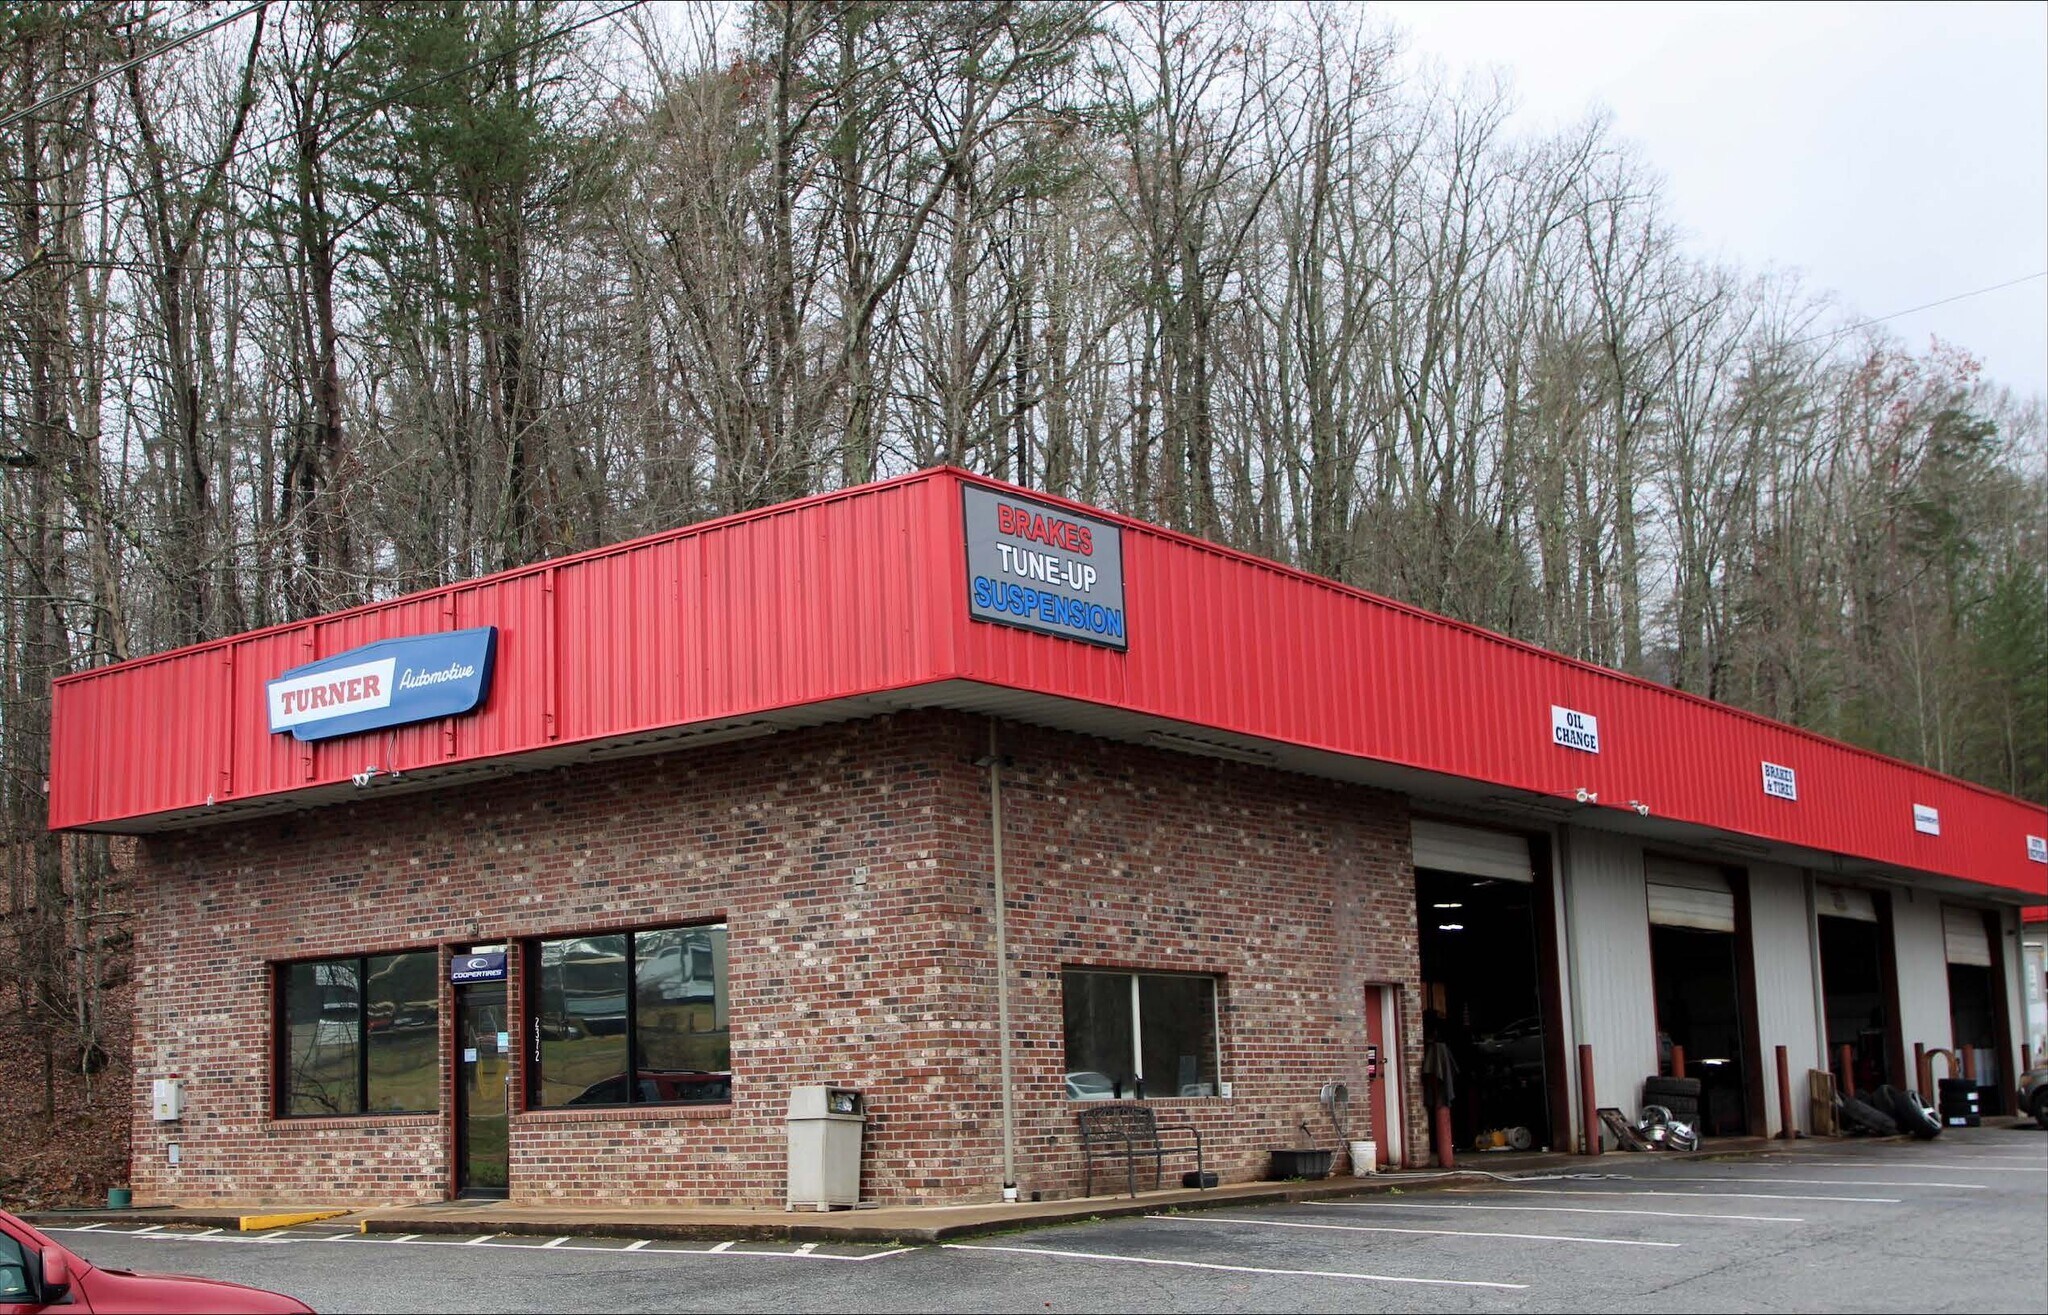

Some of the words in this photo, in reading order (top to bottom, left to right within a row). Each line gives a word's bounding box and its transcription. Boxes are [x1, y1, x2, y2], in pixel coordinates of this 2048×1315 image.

[997, 502, 1094, 556] BRAKES
[996, 542, 1098, 593] TUNE-UP
[974, 576, 1123, 638] SUSPENSION
[281, 675, 380, 715] TURNER
[399, 663, 475, 691] Automotive
[1555, 726, 1597, 750] CHANGE
[1566, 712, 1584, 730] OIL
[1765, 764, 1793, 783] BRAKES
[1773, 781, 1794, 798] TIRES
